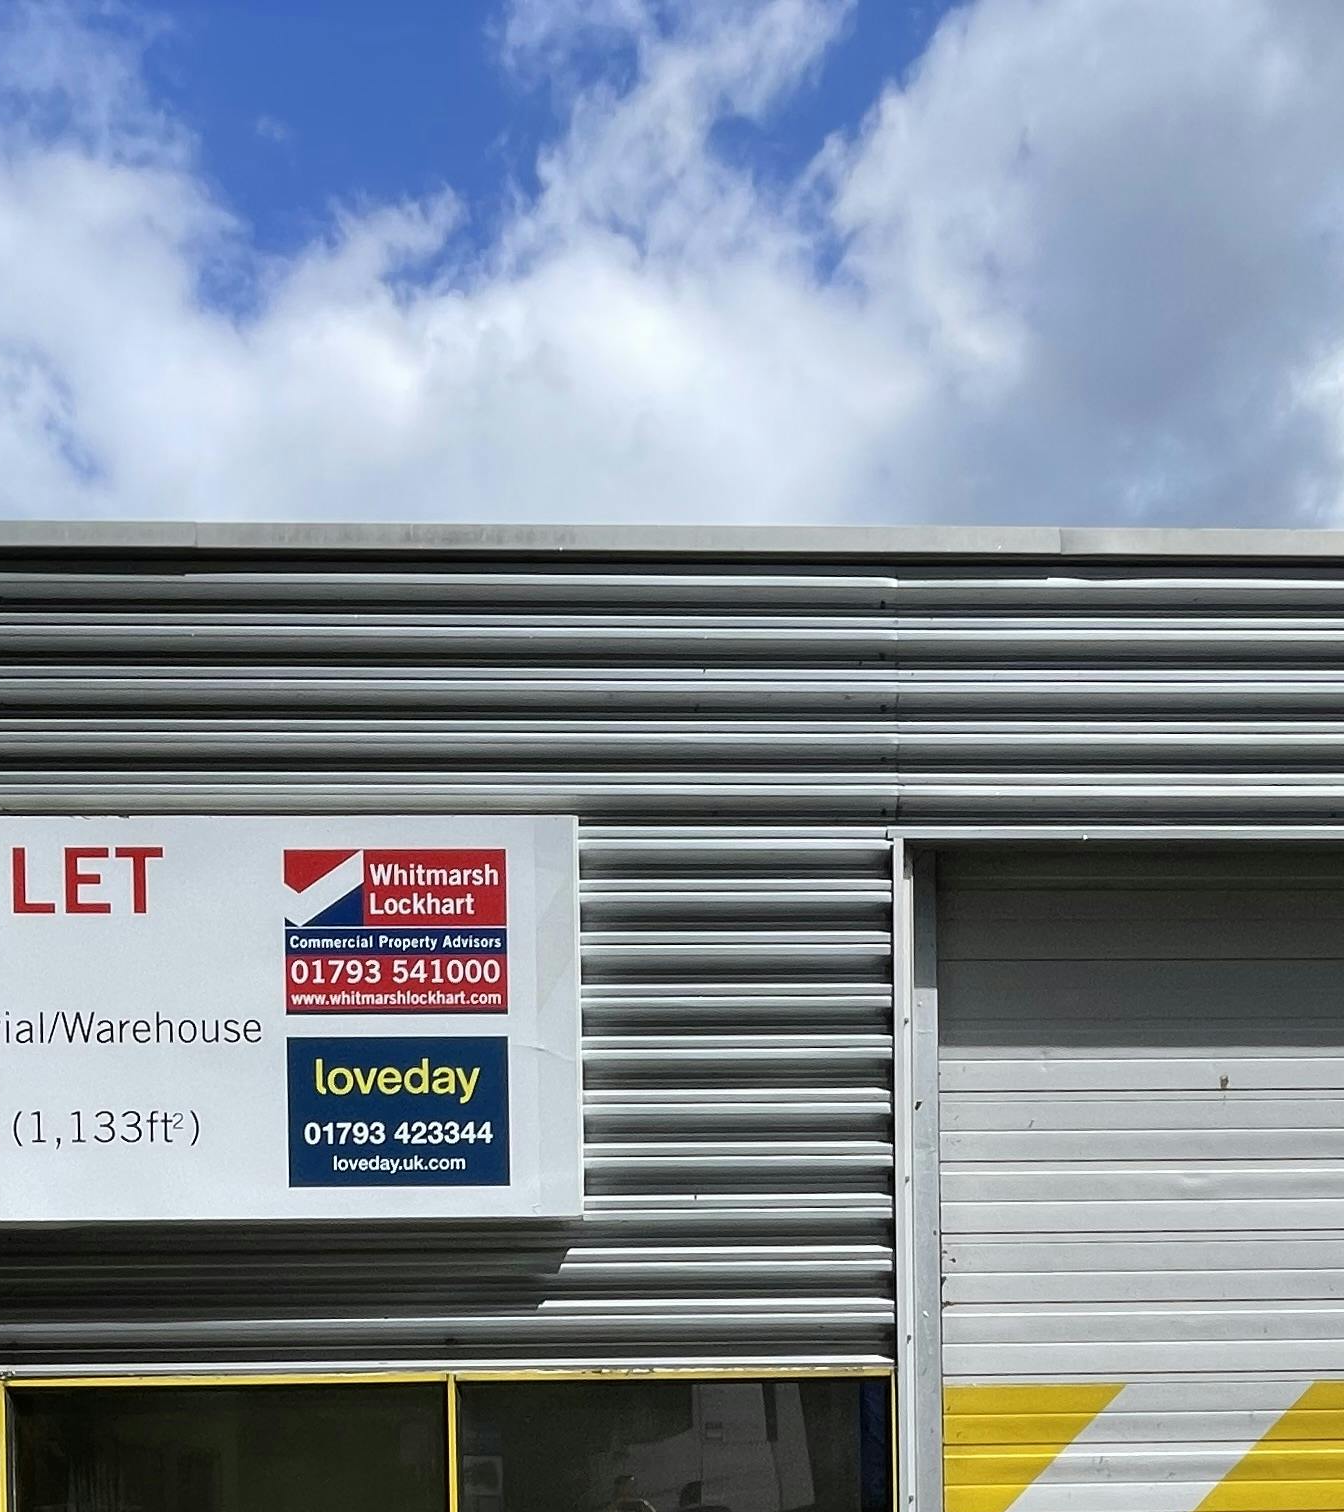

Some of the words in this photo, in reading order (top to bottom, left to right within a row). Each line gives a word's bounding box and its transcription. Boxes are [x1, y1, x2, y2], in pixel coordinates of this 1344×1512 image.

[11, 846, 164, 915] LET
[369, 863, 499, 887] Whitmarsh
[369, 893, 474, 916] Lockhart
[289, 935, 373, 949] Commercial
[379, 935, 438, 951] Property
[442, 935, 502, 949] Advisors
[290, 959, 382, 984] 01793
[392, 959, 501, 984] 541000
[291, 990, 502, 1006] www.whitmarshlockhart.com
[314, 1058, 481, 1104] loveday
[304, 1122, 386, 1145] 01793
[394, 1121, 493, 1145] 423344
[333, 1155, 466, 1173] loveday.uk.com
